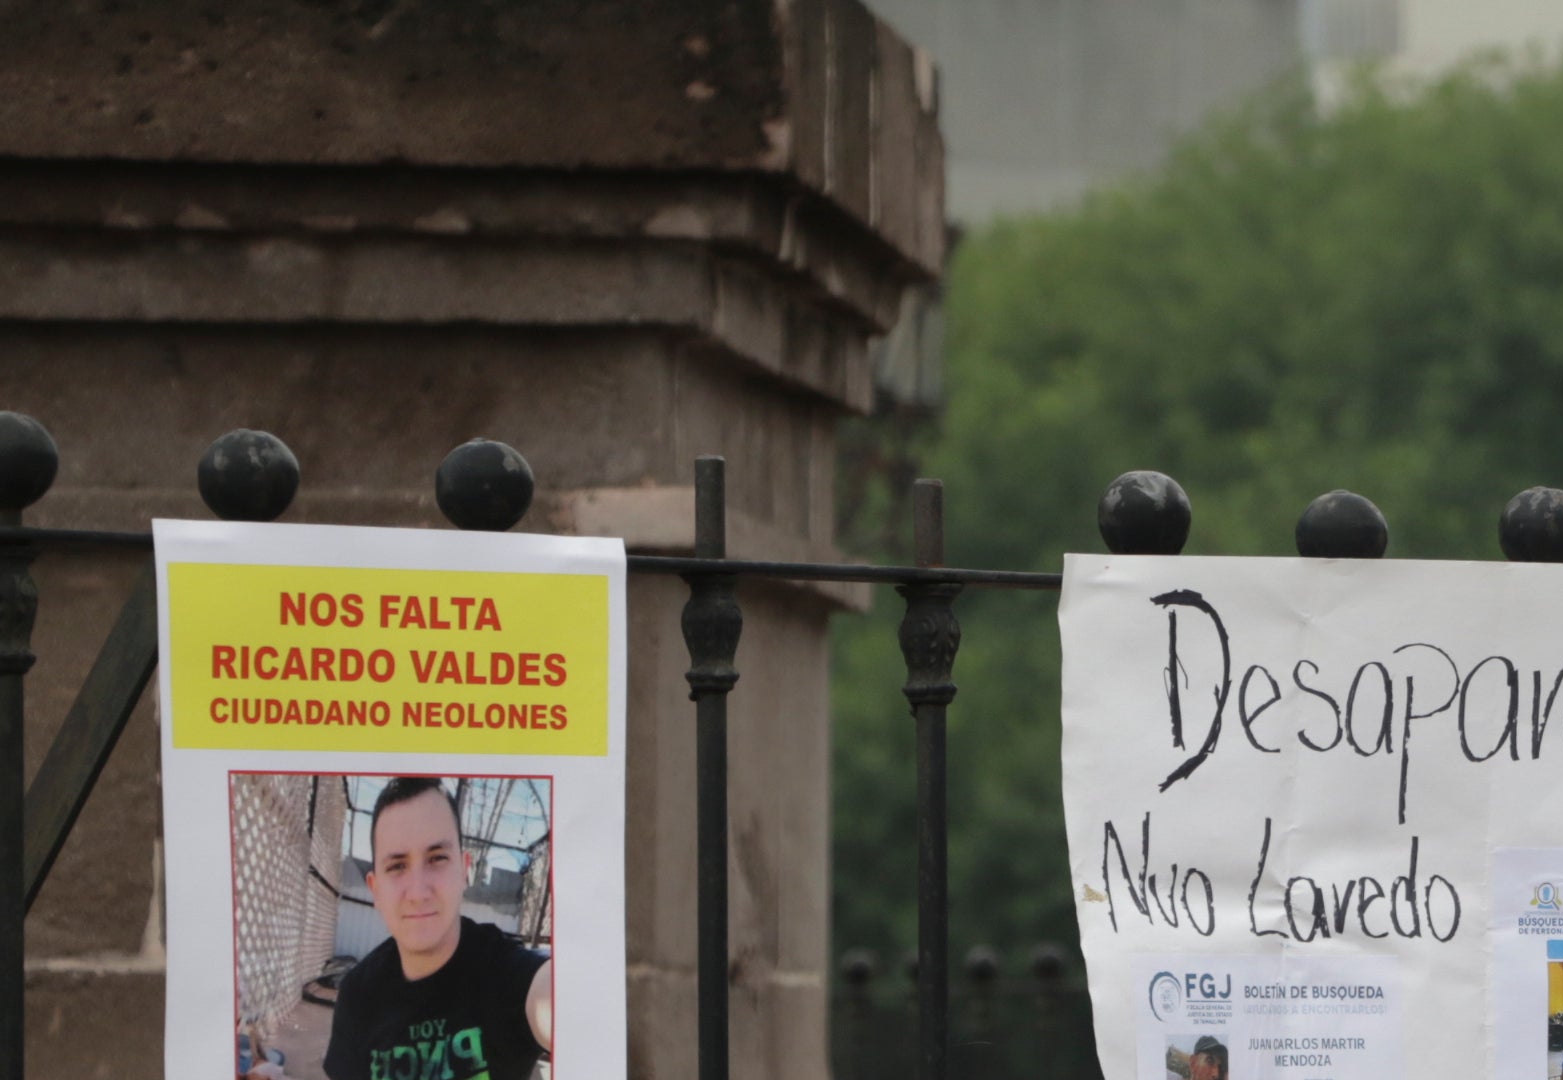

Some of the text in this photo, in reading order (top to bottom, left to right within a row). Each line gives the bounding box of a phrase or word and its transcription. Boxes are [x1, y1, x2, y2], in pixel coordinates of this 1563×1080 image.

[280, 592, 502, 631] NOS FALTA
[211, 645, 567, 687] RICARDO VALDES
[210, 697, 568, 730] CIUDADANO NEOLONES
[1102, 811, 1462, 945] Nvo Laredo
[1518, 927, 1529, 935] DE
[1185, 973, 1231, 999] FGJ
[1244, 982, 1385, 1000] BOLETÍN DE BUSQUEDA
[1248, 1037, 1366, 1050] JUAN CARLOS MARTIR
[1275, 1055, 1332, 1067] MENDOZA
